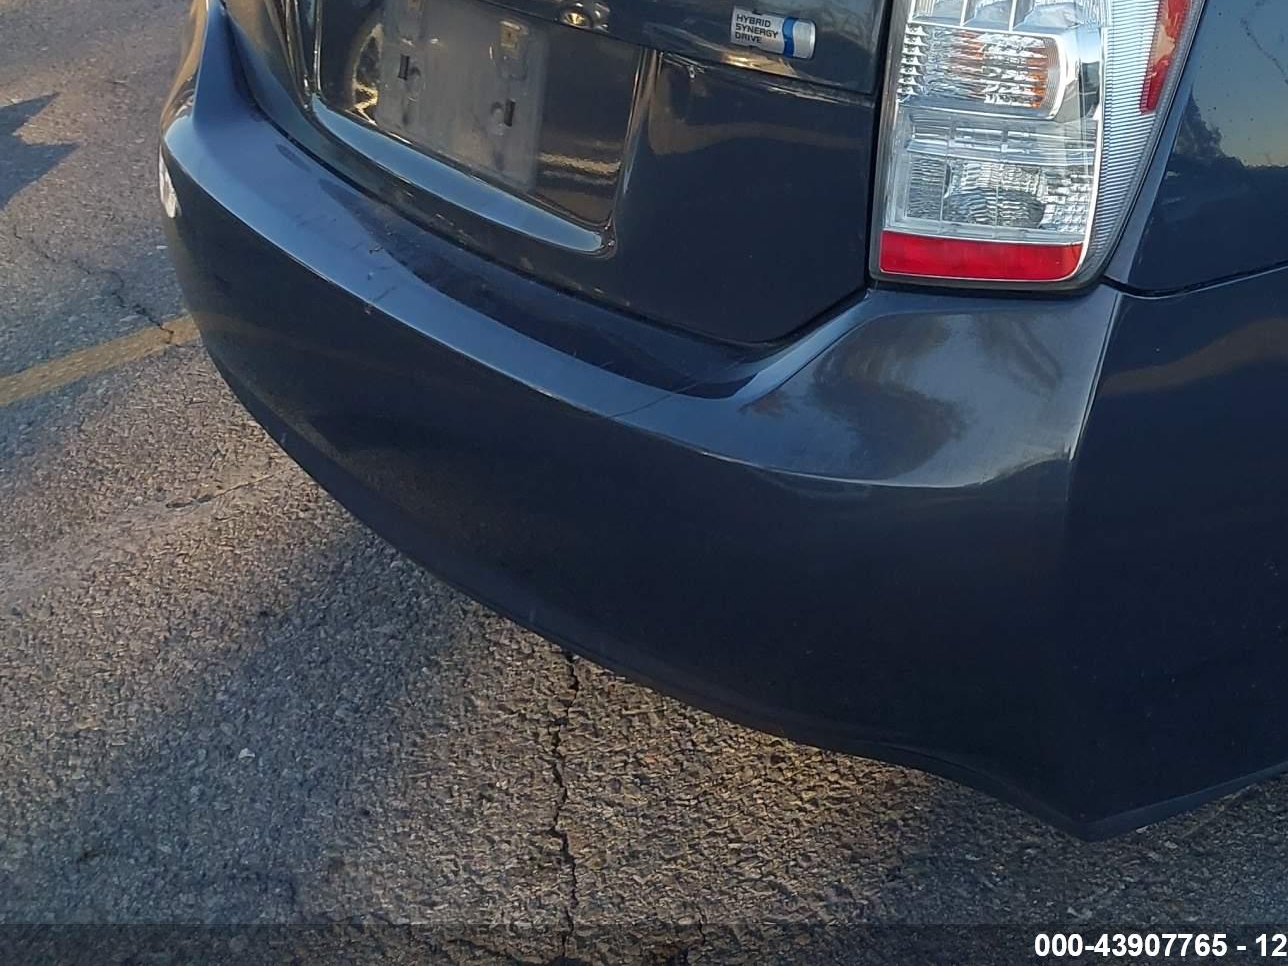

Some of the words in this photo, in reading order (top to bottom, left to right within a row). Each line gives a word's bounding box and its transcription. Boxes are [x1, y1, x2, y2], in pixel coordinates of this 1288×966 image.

[736, 14, 771, 28] HYBRID
[735, 22, 778, 39] SYNERGY
[735, 32, 762, 43] DRIVE
